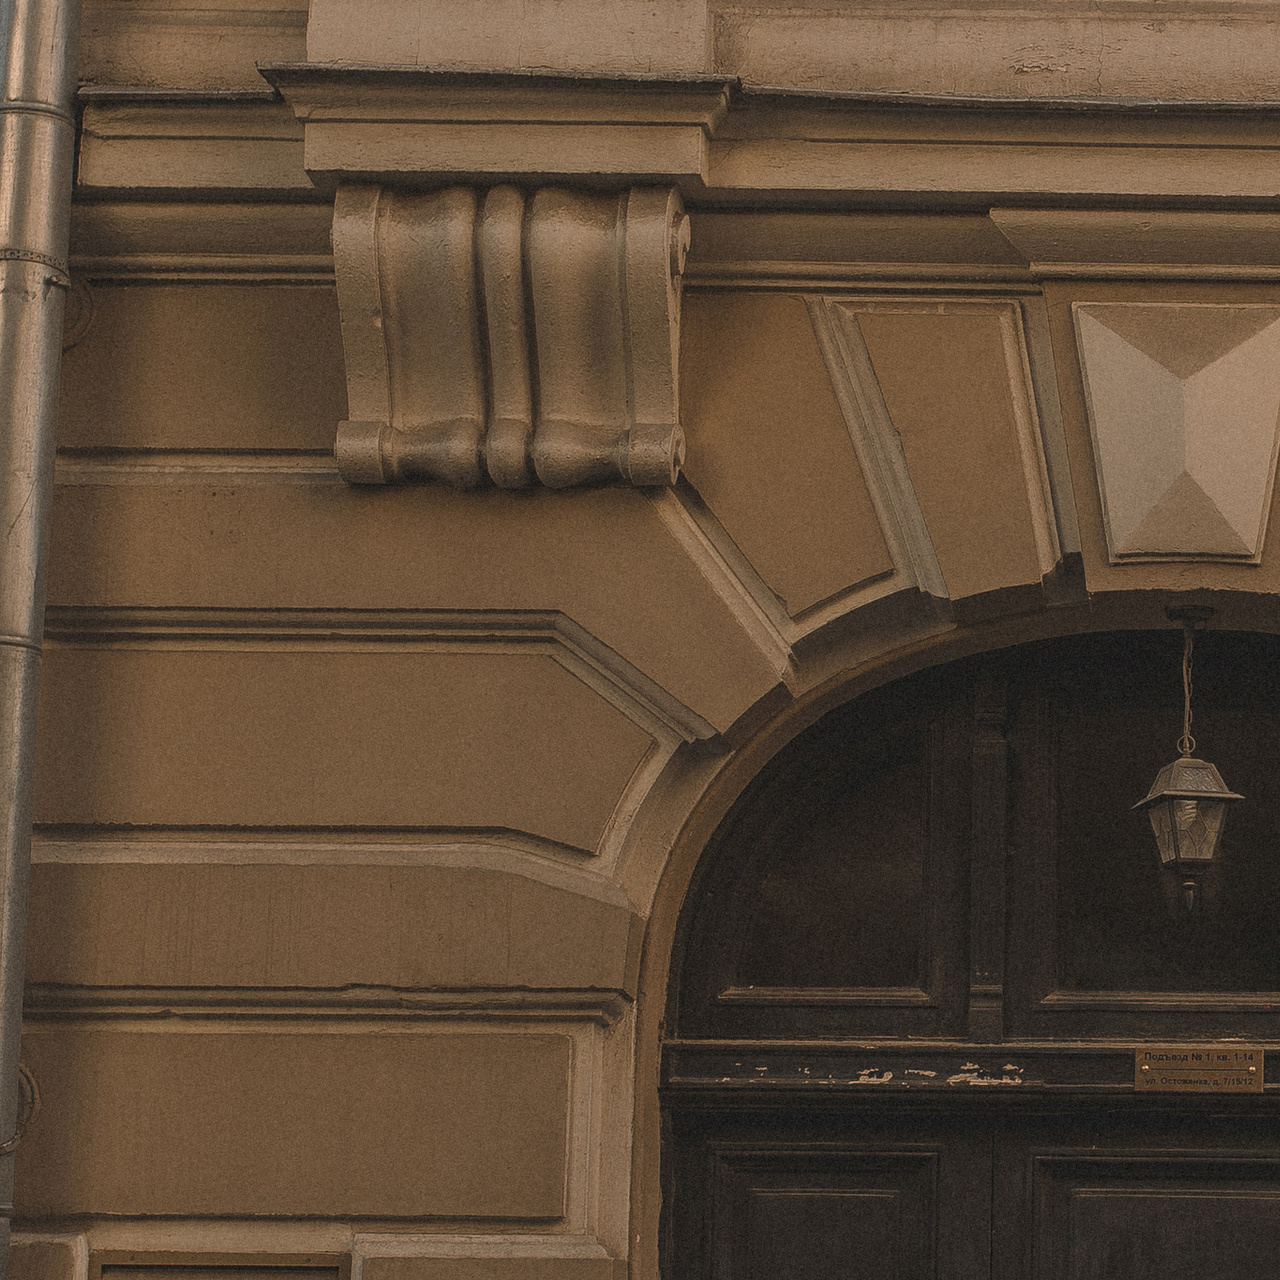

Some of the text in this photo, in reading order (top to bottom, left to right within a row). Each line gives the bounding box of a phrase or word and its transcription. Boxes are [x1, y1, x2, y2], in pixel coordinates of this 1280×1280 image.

[1144, 1052, 1188, 1062] Подъезд
[1191, 1052, 1202, 1061] №
[1205, 1052, 1213, 1062] 1,
[1234, 1052, 1254, 1061] 1-14
[1223, 1077, 1253, 1086] 7/15/12
